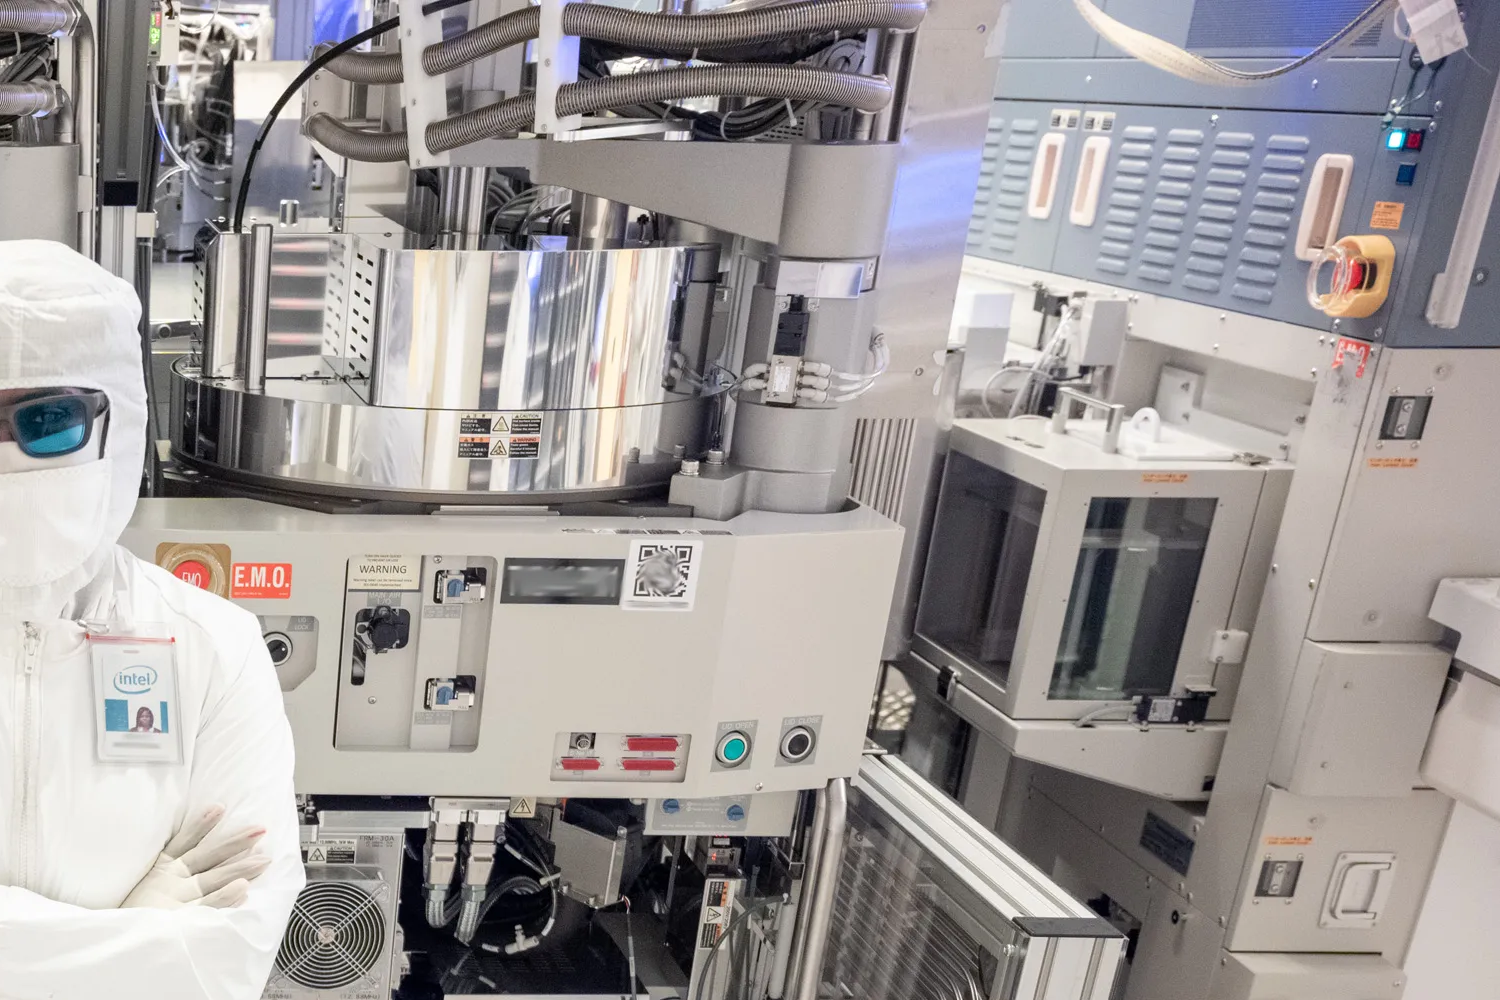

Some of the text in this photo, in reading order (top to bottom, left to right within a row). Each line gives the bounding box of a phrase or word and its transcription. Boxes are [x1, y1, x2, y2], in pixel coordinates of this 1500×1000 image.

[359, 565, 407, 574] WARNING
[182, 572, 201, 587] EMO
[234, 566, 290, 588] E.M.O.
[119, 671, 150, 686] intel
[735, 721, 755, 729] OPEN
[784, 716, 820, 726] LID CLOSE
